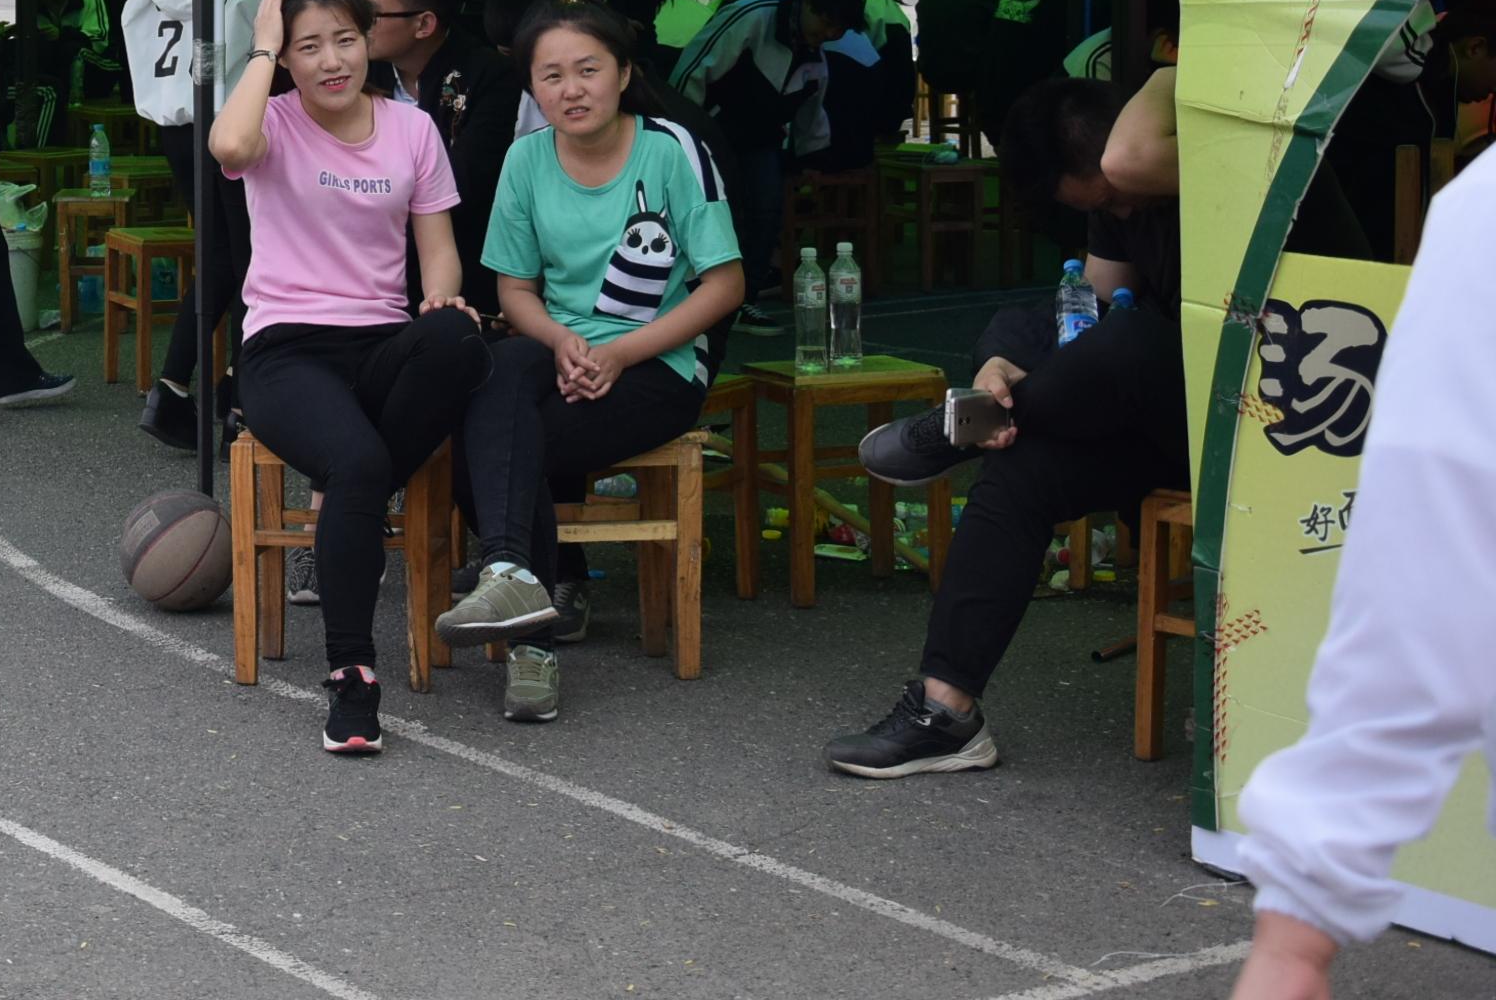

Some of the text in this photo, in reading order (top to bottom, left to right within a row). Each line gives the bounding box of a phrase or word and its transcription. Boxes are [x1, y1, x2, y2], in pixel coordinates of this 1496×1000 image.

[154, 20, 193, 79] 2
[353, 178, 392, 194] PORTS
[1260, 306, 1378, 448] 汤
